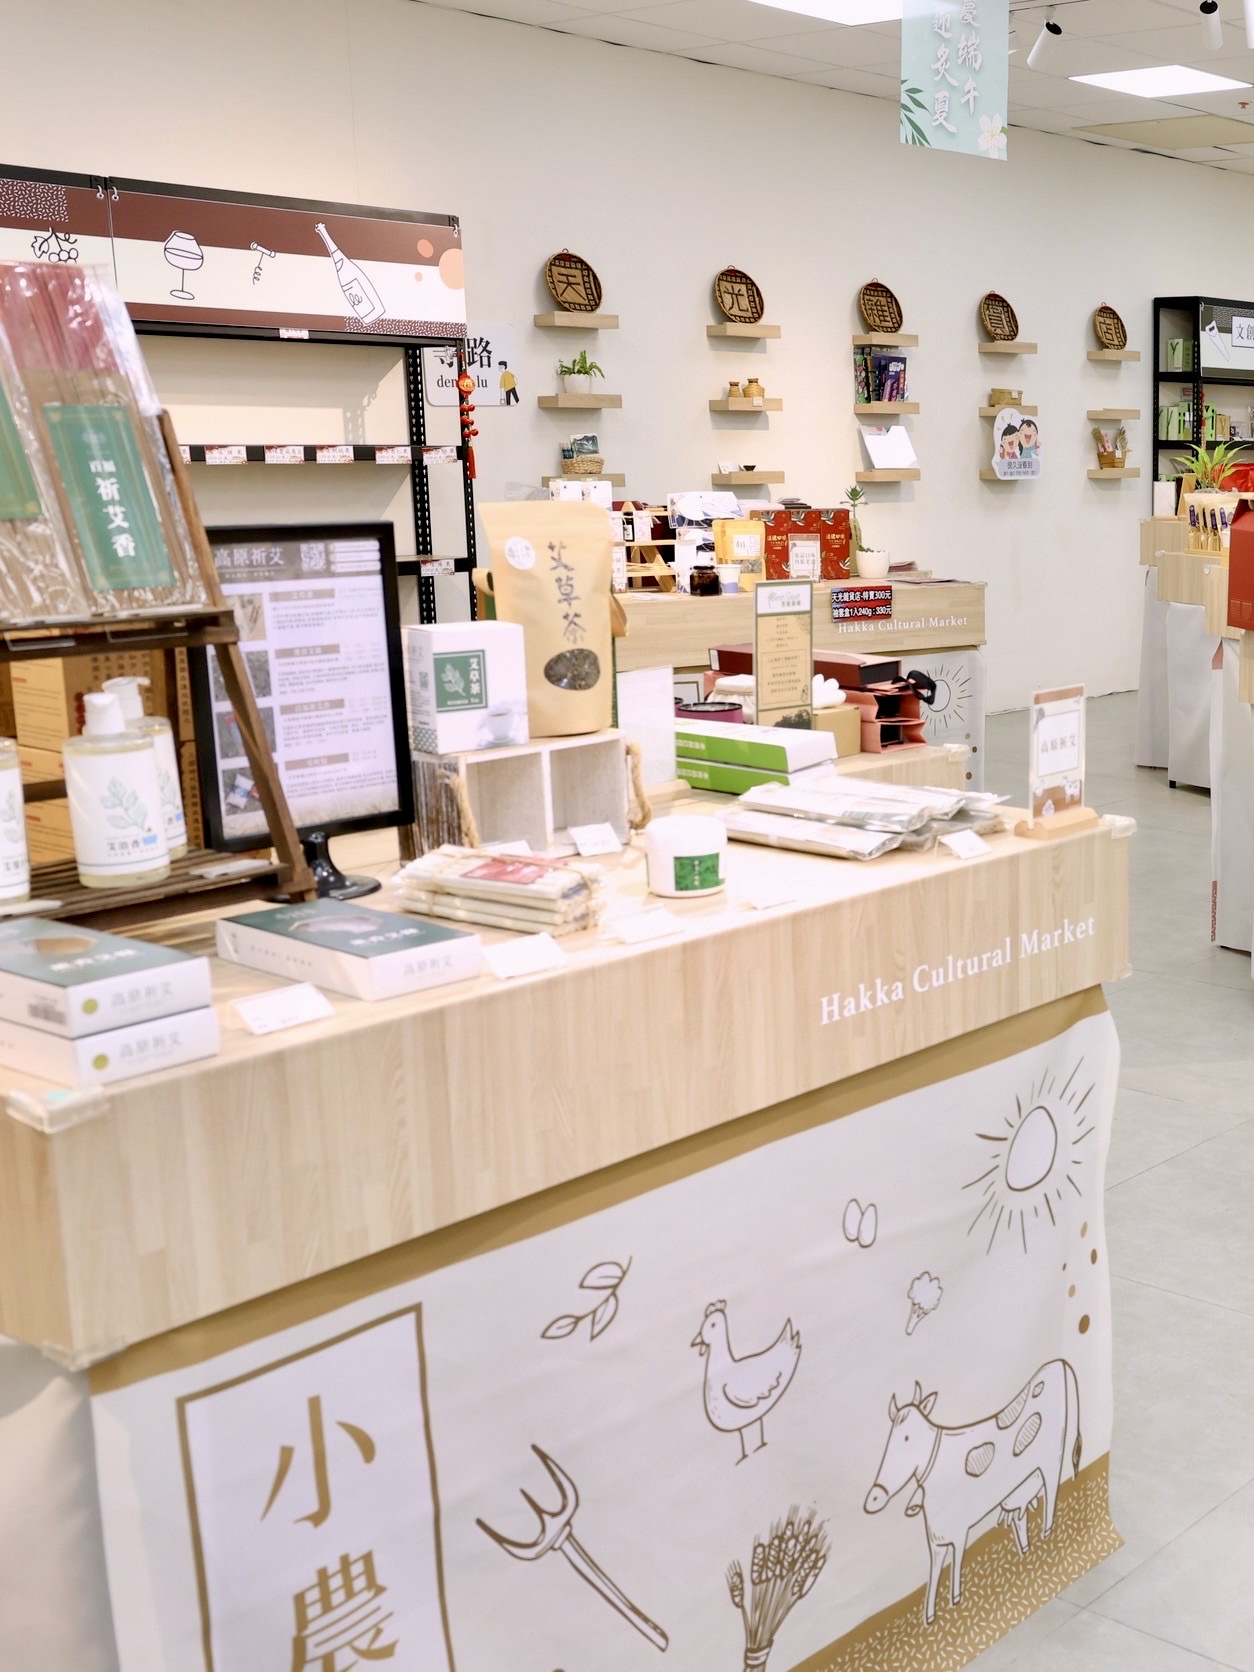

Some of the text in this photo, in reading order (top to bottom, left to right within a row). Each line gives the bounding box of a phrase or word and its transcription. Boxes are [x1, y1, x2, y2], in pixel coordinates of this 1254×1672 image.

[95, 476, 136, 558] 祈艾香
[546, 540, 588, 646] 艾草茶
[838, 615, 968, 633] Hakka Cultural Market
[819, 915, 1097, 1026] Hakka Cultural Market
[260, 1394, 399, 1672] 小農
